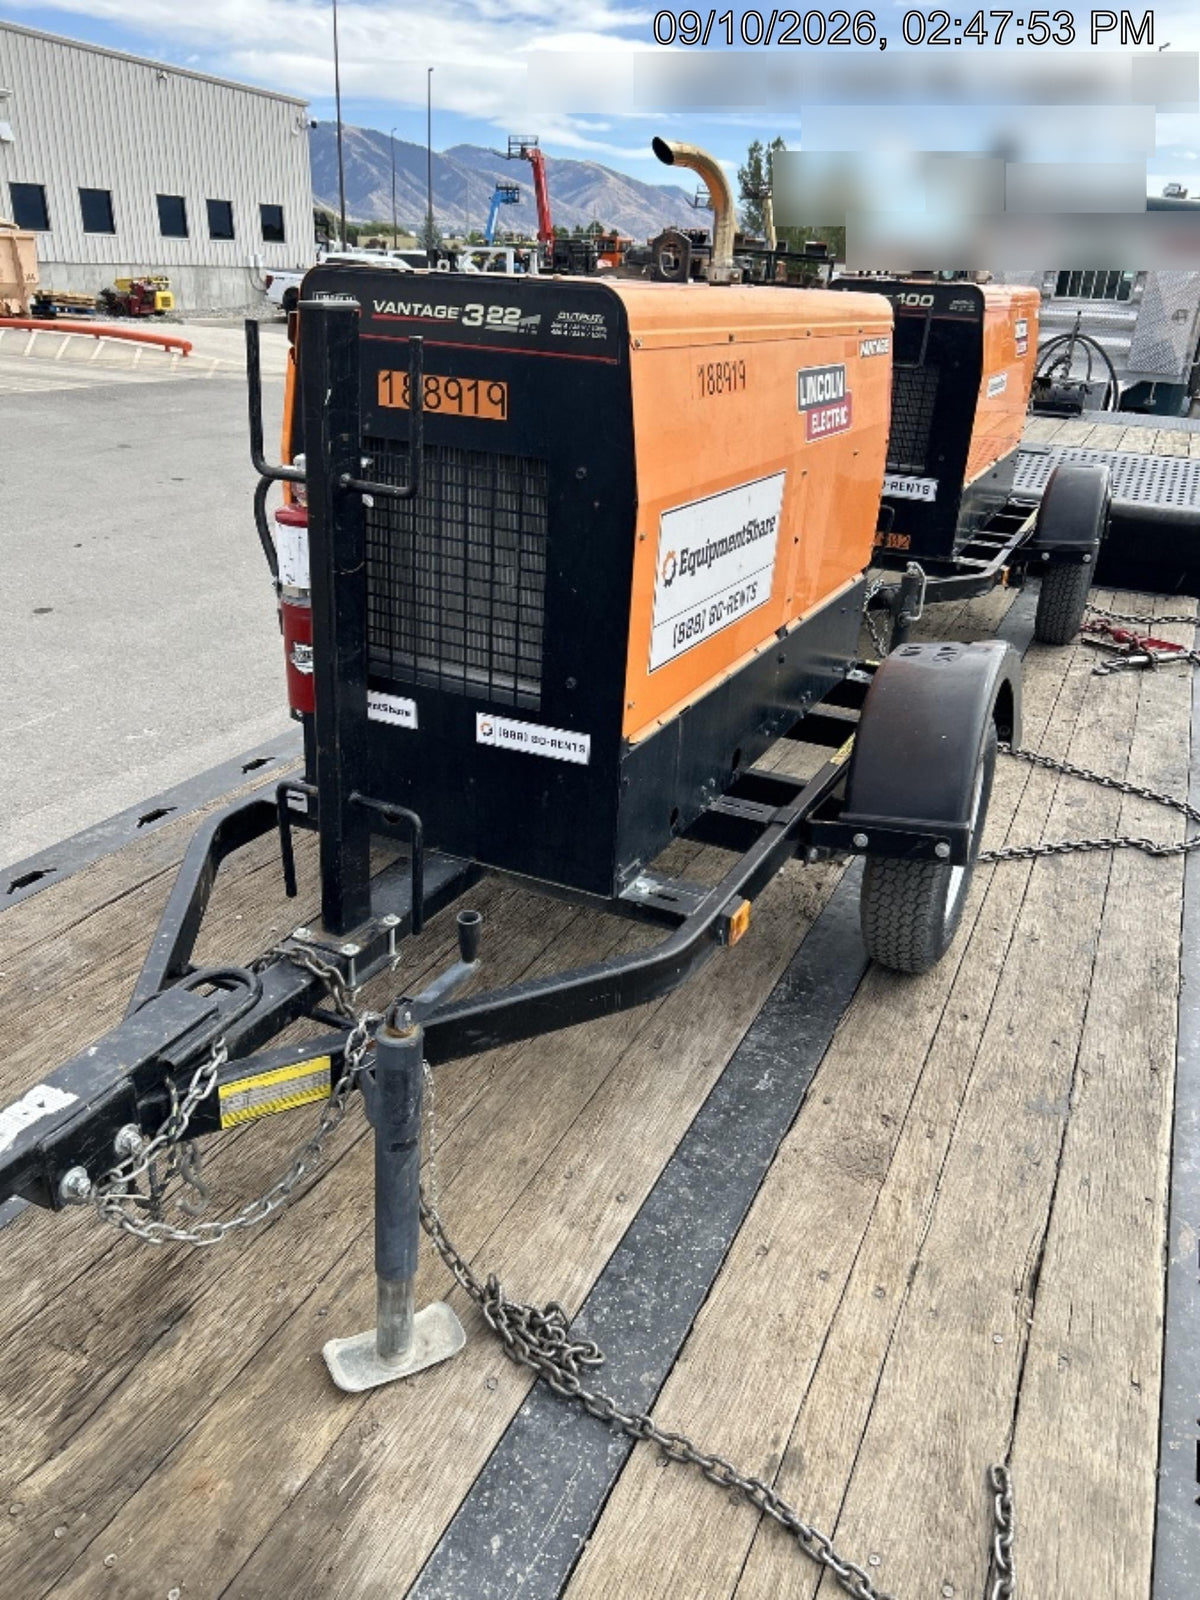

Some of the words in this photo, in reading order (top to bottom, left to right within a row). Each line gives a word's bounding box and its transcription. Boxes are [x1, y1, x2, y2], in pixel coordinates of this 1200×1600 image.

[373, 300, 460, 320] VANTAGE
[461, 303, 522, 327] 322
[696, 359, 747, 397] 188919
[799, 368, 845, 406] LINCOLN
[810, 405, 849, 435] ELECTRIC
[678, 514, 776, 578] EquipmentShare
[672, 609, 706, 649] (888)
[708, 580, 759, 626] GO-RENTS
[498, 726, 529, 743] (888)
